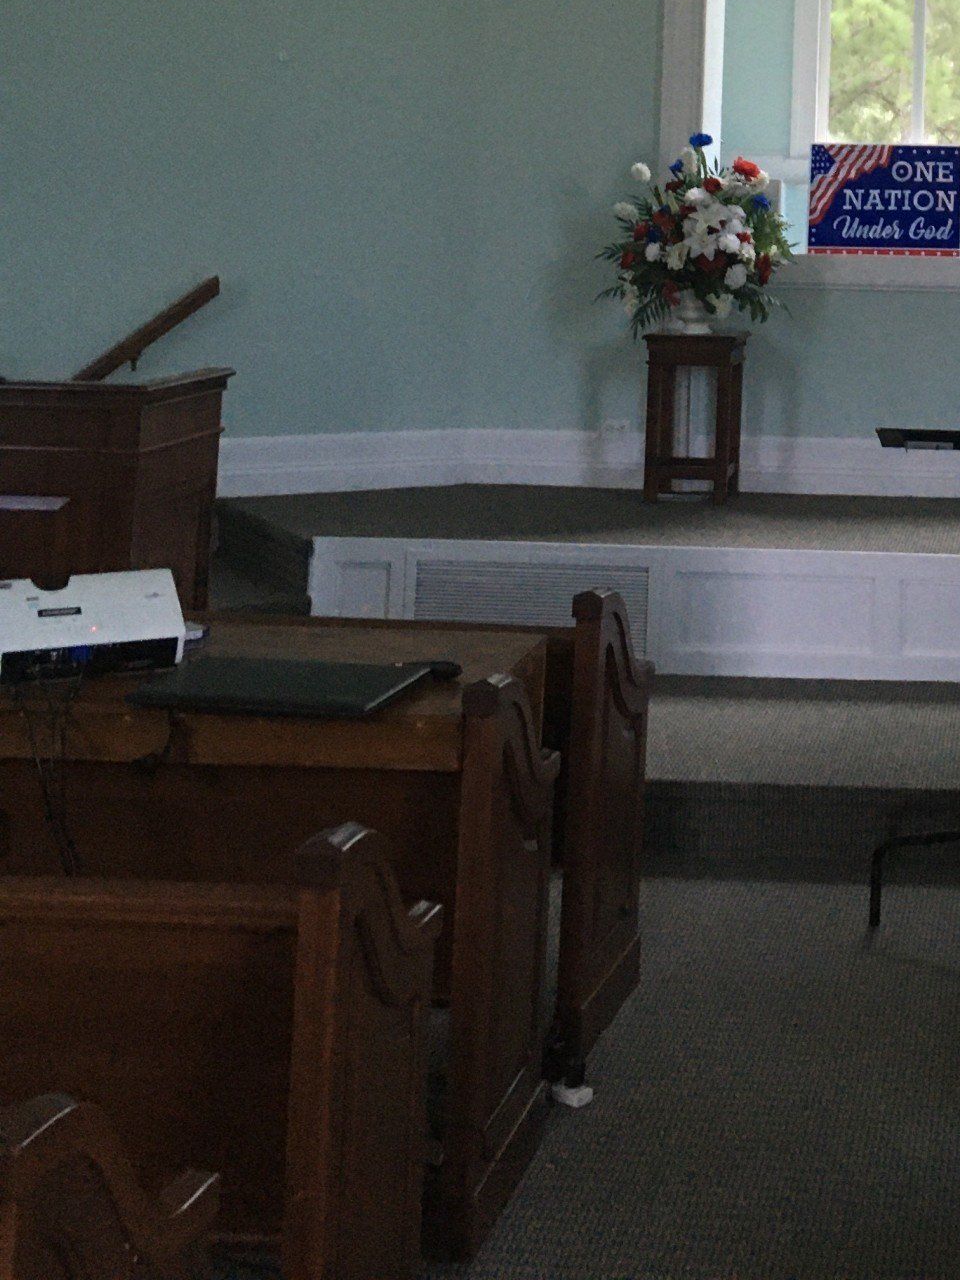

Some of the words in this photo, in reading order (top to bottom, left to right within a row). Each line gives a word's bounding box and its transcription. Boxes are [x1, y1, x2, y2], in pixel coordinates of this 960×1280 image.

[891, 161, 954, 183] ONE
[842, 189, 958, 212] NATION
[833, 215, 904, 239] Under
[908, 217, 954, 240] God
